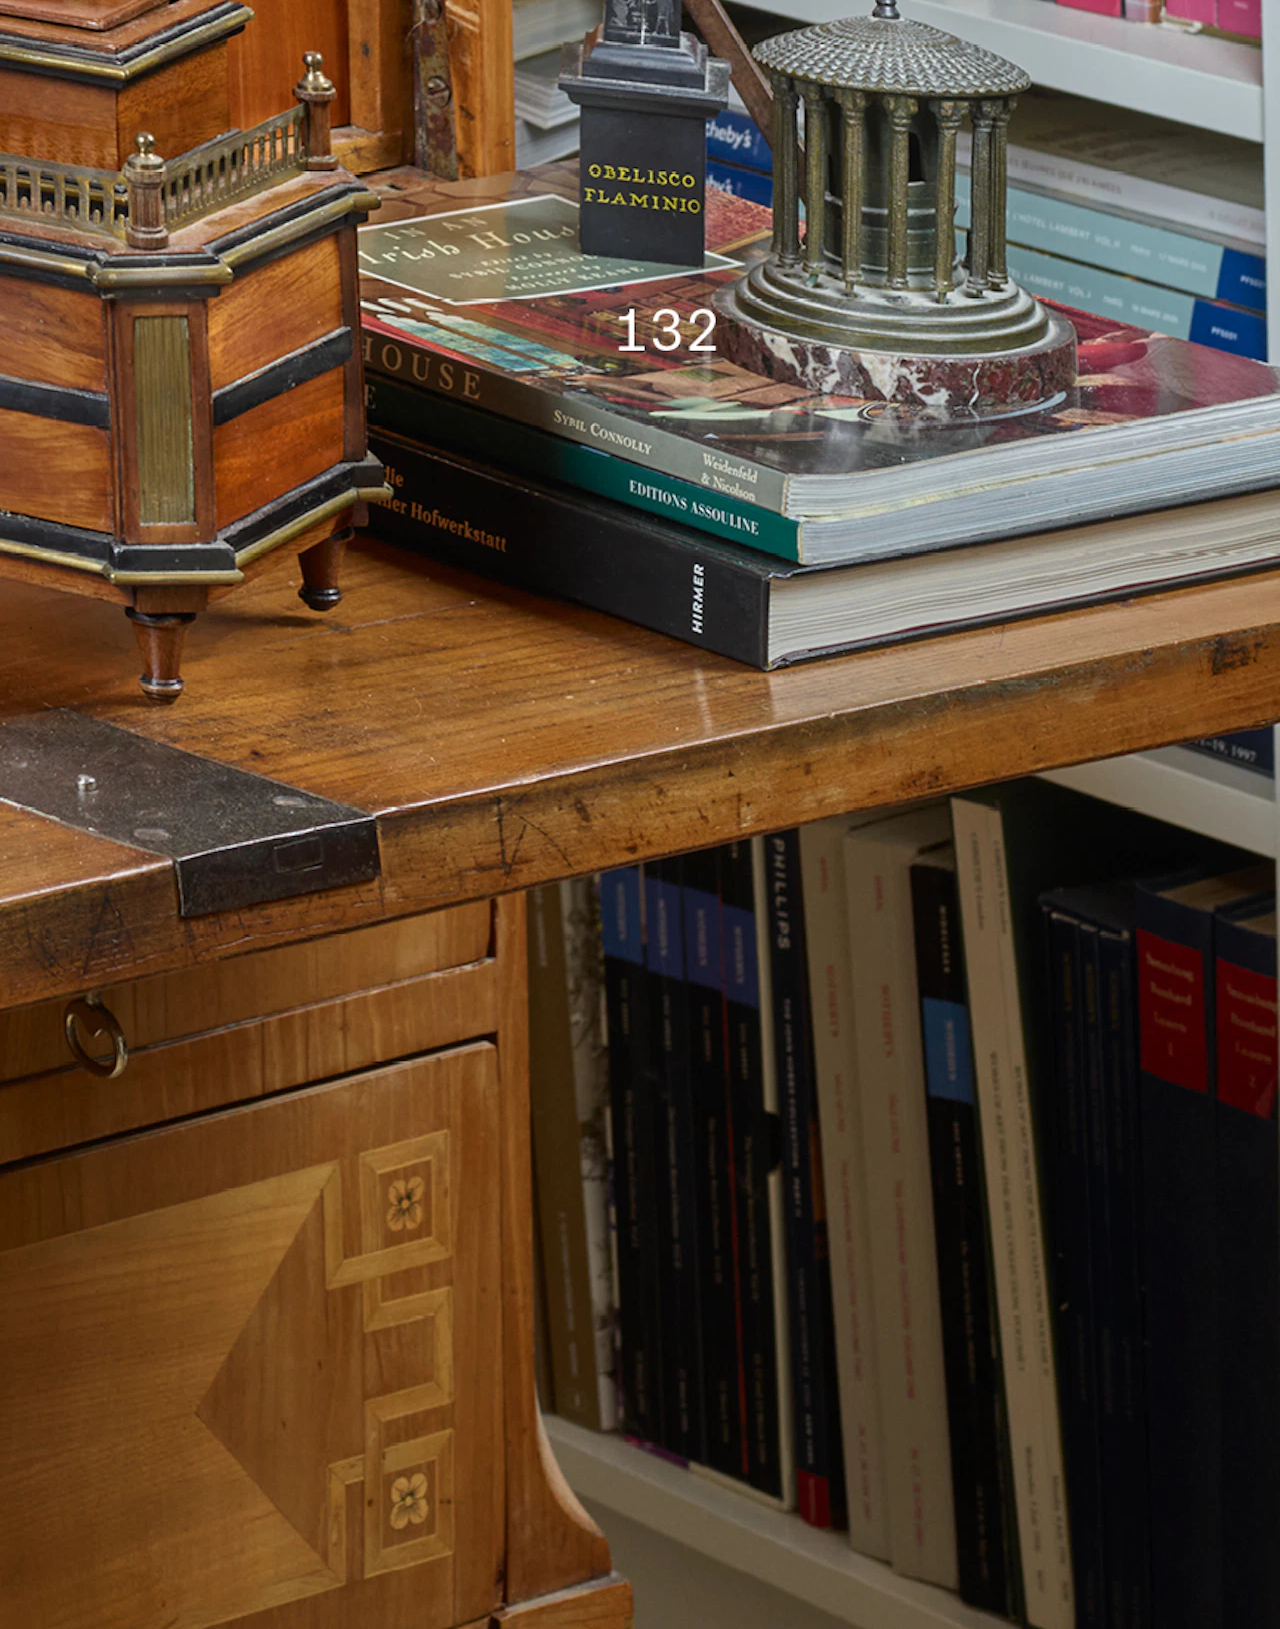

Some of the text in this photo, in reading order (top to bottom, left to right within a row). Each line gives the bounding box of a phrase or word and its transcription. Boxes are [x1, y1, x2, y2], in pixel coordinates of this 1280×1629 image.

[588, 161, 698, 189] OBELISCO
[583, 186, 702, 216] FLAMINIO
[700, 471, 758, 503] & Nicolson
[702, 450, 759, 485] Weidenfeld
[410, 505, 508, 554] Hofwerkstatt
[628, 479, 761, 538] EDITIONS ASSOULINE
[692, 563, 706, 635] HIRMER
[773, 837, 791, 951] PHILLIPS
